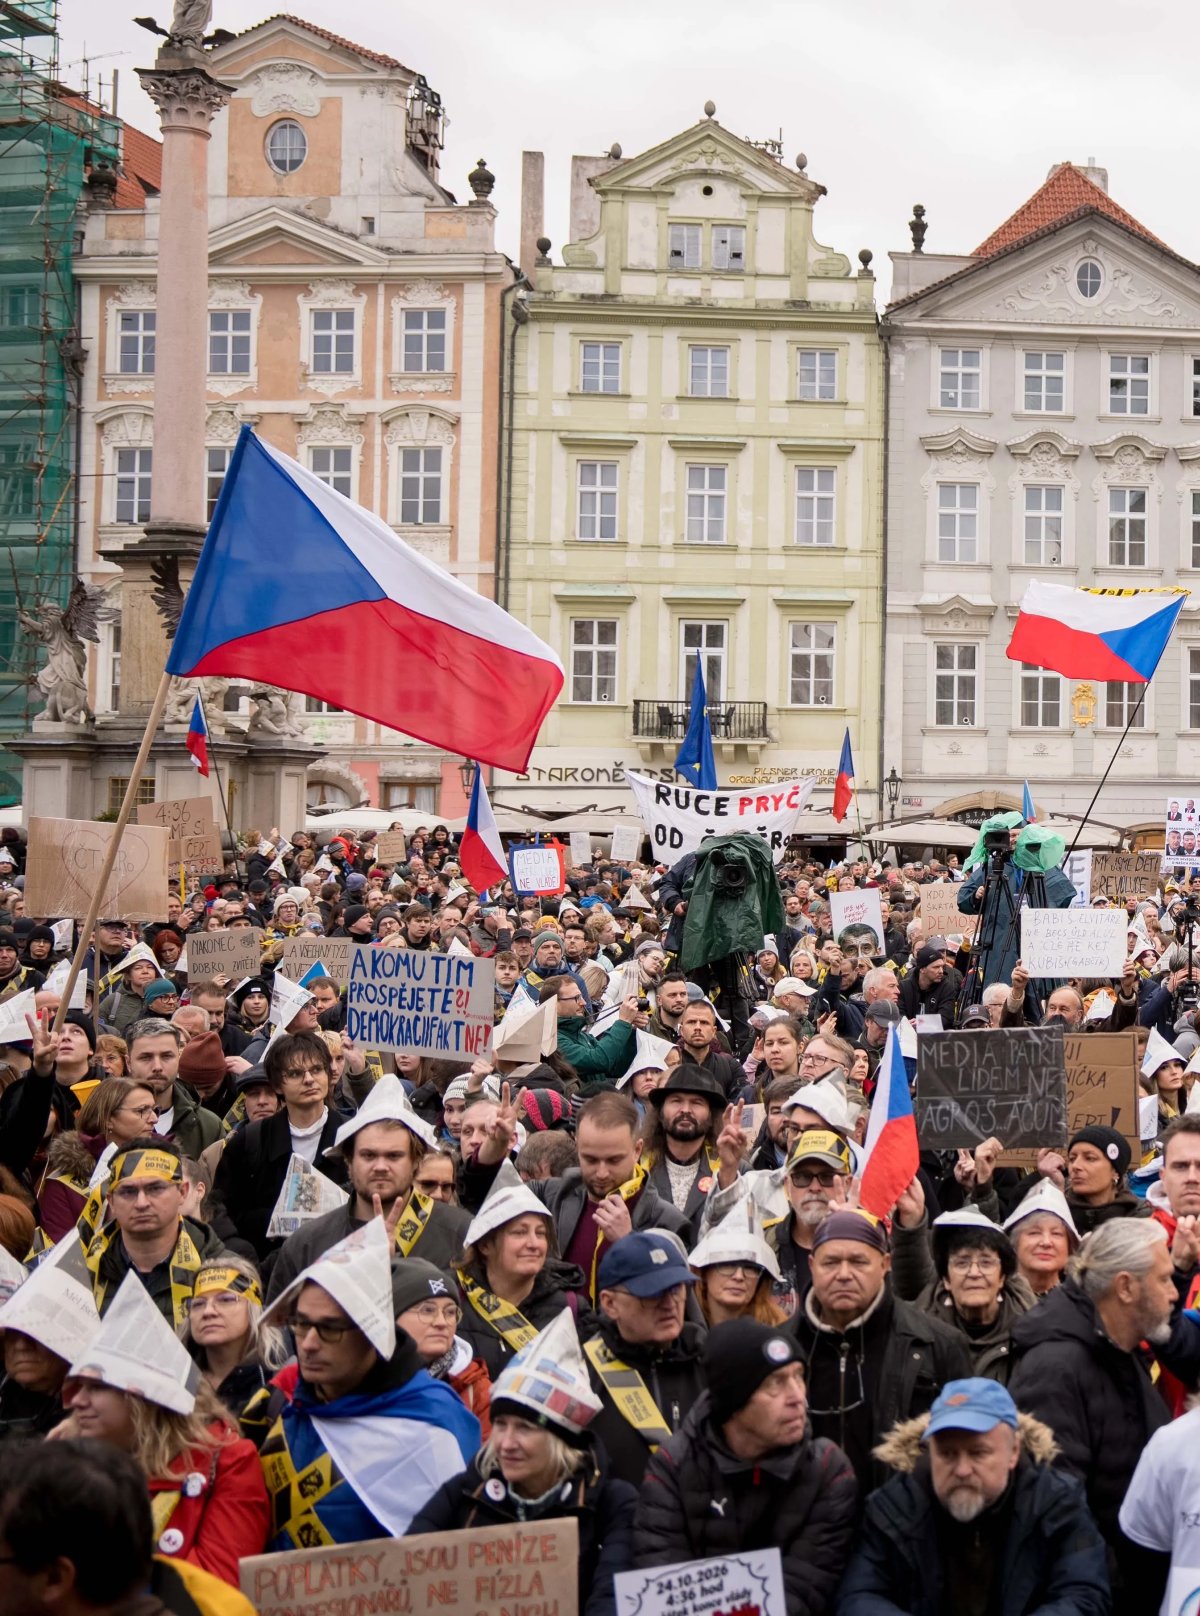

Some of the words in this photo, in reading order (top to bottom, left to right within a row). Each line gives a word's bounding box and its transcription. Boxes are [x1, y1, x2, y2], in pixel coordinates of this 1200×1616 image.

[729, 776, 774, 784] ORIGINAL
[655, 785, 730, 816] RUCE
[738, 786, 800, 816] PRYČ
[156, 801, 191, 822] 4:36
[655, 824, 683, 849] OD
[74, 843, 100, 869] ČT
[187, 838, 210, 857] ČERT
[1095, 856, 1109, 871] MY
[1111, 857, 1132, 871] JSME
[926, 890, 944, 900] KDO
[1099, 876, 1149, 893] REVOLUCE
[928, 915, 976, 930] DEMOK
[191, 936, 235, 955] NAKONEC
[193, 962, 225, 974] DOBRO
[351, 949, 367, 980] A
[372, 949, 426, 981] KOMU
[431, 955, 474, 987] TÍM
[254, 1551, 386, 1600] POPLATKY
[401, 1545, 458, 1578] JSOU
[468, 1531, 558, 1568] PENÍZE
[427, 1579, 458, 1606] NE
[475, 1569, 545, 1602] FÍZLA
[656, 1564, 729, 1595] 24.10.2026
[666, 1589, 696, 1607] 4:36
[700, 1580, 724, 1597] hod
